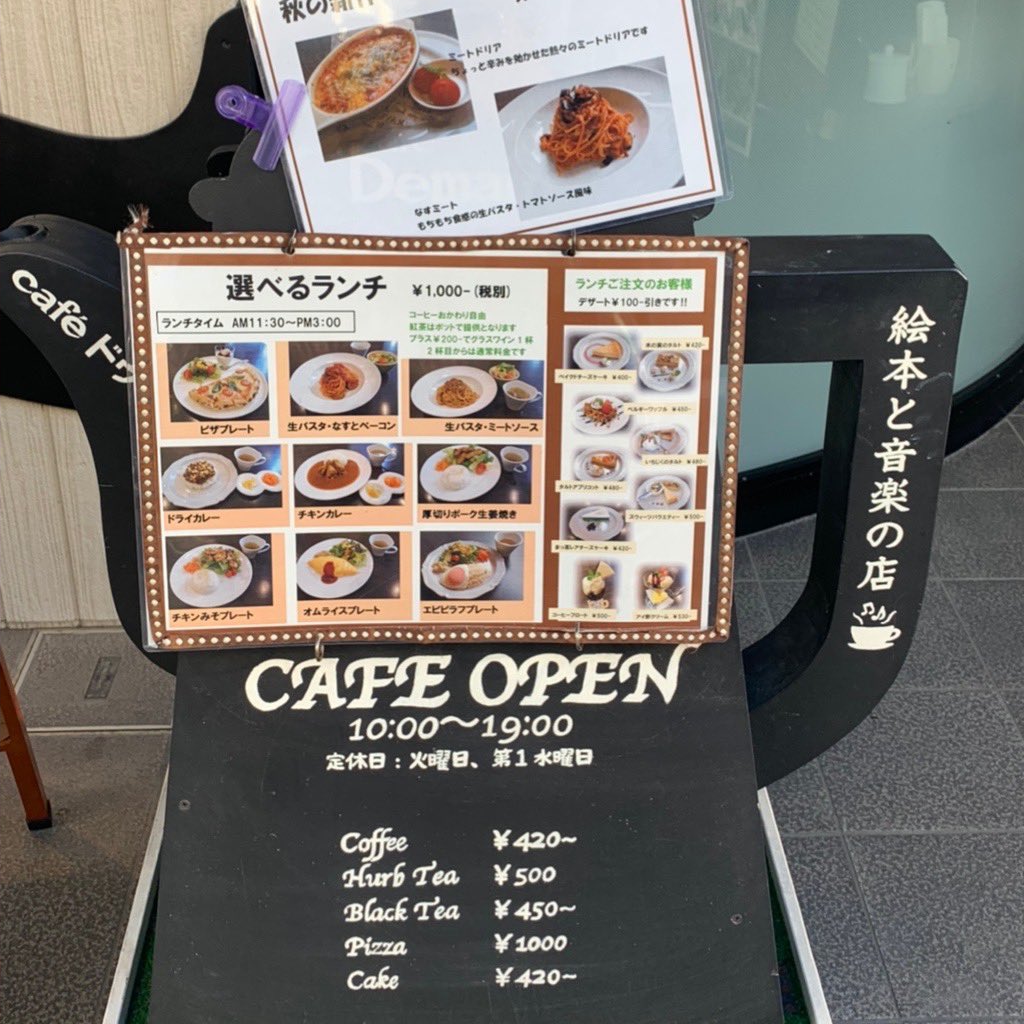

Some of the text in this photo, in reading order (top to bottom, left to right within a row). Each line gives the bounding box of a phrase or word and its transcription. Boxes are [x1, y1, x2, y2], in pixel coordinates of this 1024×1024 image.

[448, 41, 502, 62] ミートドリア
[414, 201, 458, 217] なすミート
[226, 274, 387, 300] 選べるランチ
[576, 278, 693, 290] ランチご注文のお客様
[12, 269, 89, 339] Café
[161, 317, 224, 329] ランチタイム
[200, 423, 255, 435] ピザプレート
[287, 421, 397, 432] 生パスタ・なすとベーコン
[445, 422, 539, 433] 生パスタ・ミートソース
[857, 305, 936, 591] 絵本と音楽の店
[166, 512, 220, 524] ドライカレー
[297, 509, 352, 520] チキンカレー
[172, 610, 254, 623] チキンみそプレート
[303, 605, 380, 617] オムライスプレート
[422, 604, 499, 615] エビピラフプレート
[244, 643, 702, 712] CAFE OPEN
[340, 827, 409, 863] Coffee
[341, 860, 557, 888] Hurb Tea ¥500
[343, 897, 410, 922] Black
[413, 896, 460, 921] Tea
[344, 933, 568, 957] Pizza ¥1000
[346, 966, 399, 990] Cake
